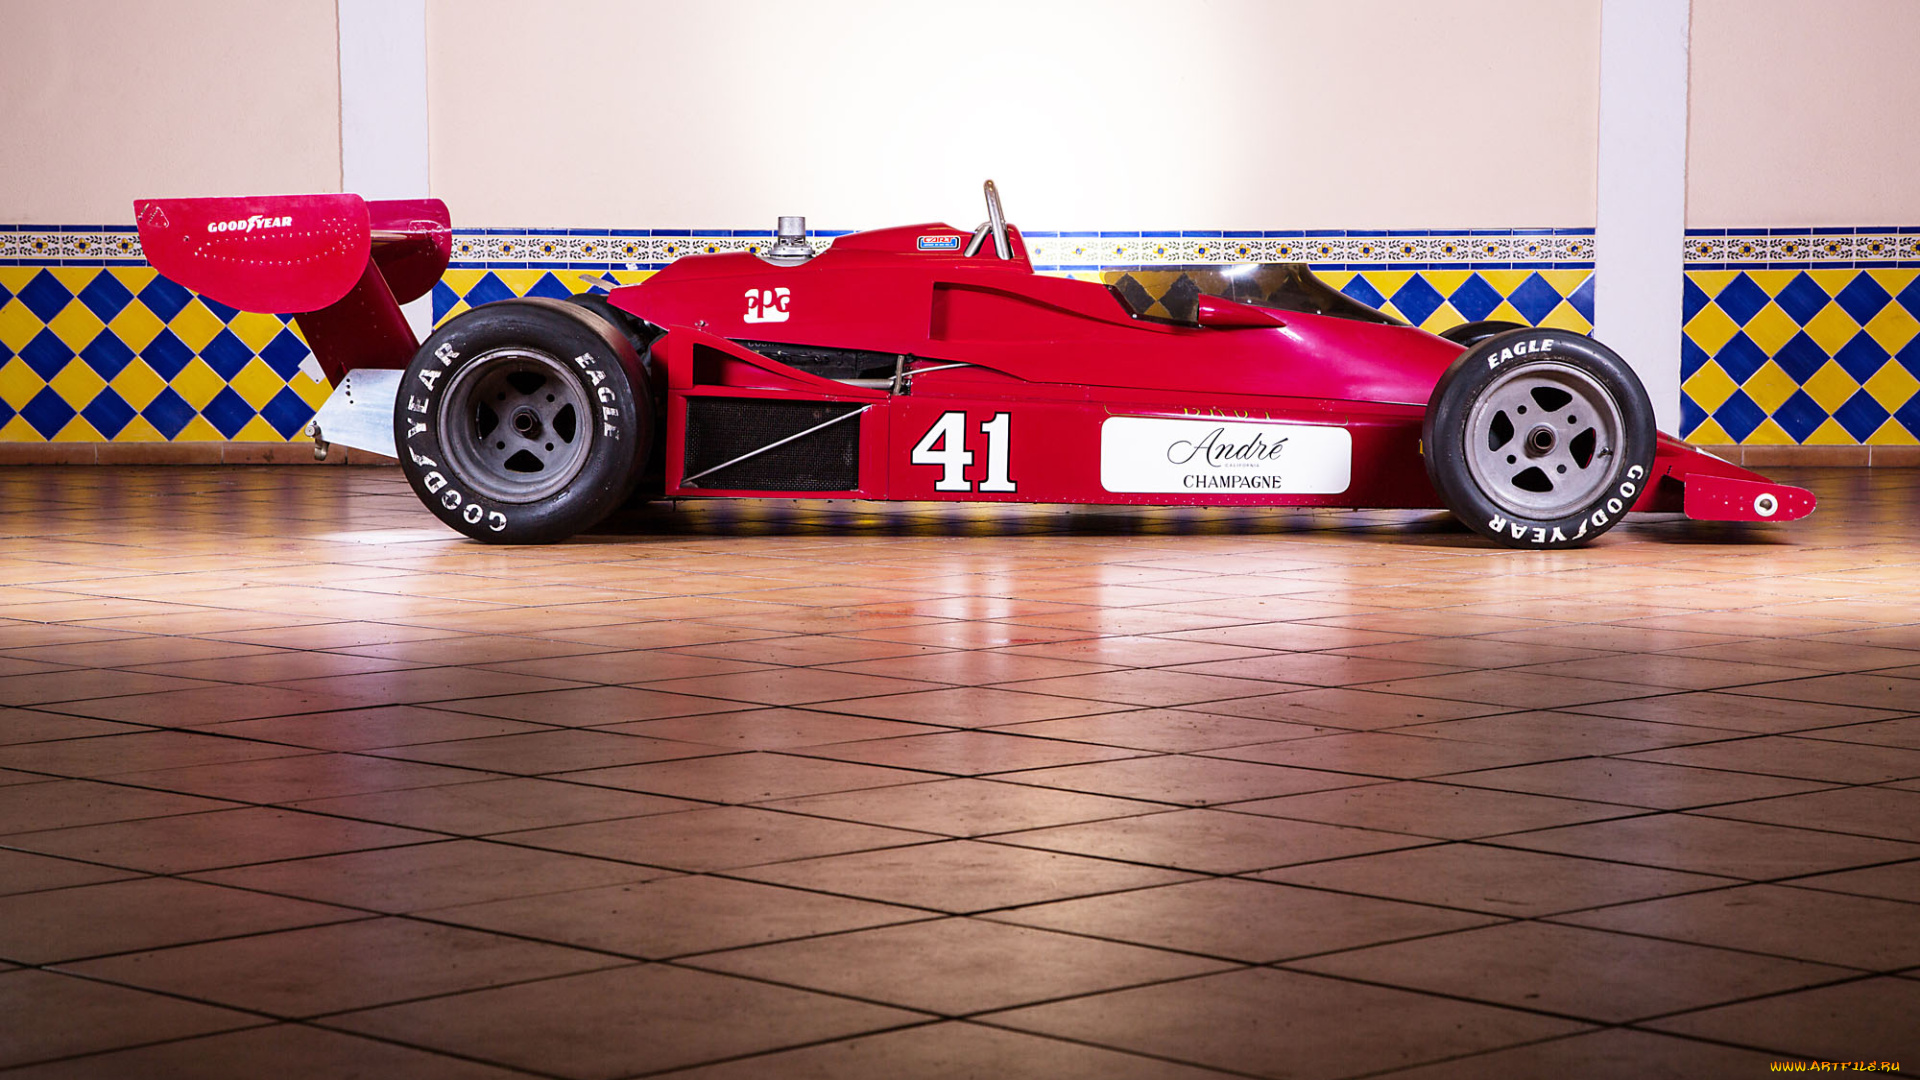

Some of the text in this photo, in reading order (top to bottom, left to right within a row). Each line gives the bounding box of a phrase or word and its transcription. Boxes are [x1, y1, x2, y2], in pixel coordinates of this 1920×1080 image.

[207, 215, 293, 233] GOODYEAR
[1487, 339, 1554, 370] EAGLE
[575, 353, 618, 440] EAGLE
[407, 342, 508, 532] GOODYEAR
[910, 410, 1018, 494] 41
[1167, 427, 1289, 468] André
[1183, 474, 1282, 489] CHAMPAGNE
[1489, 464, 1644, 544] GOODYEAR
